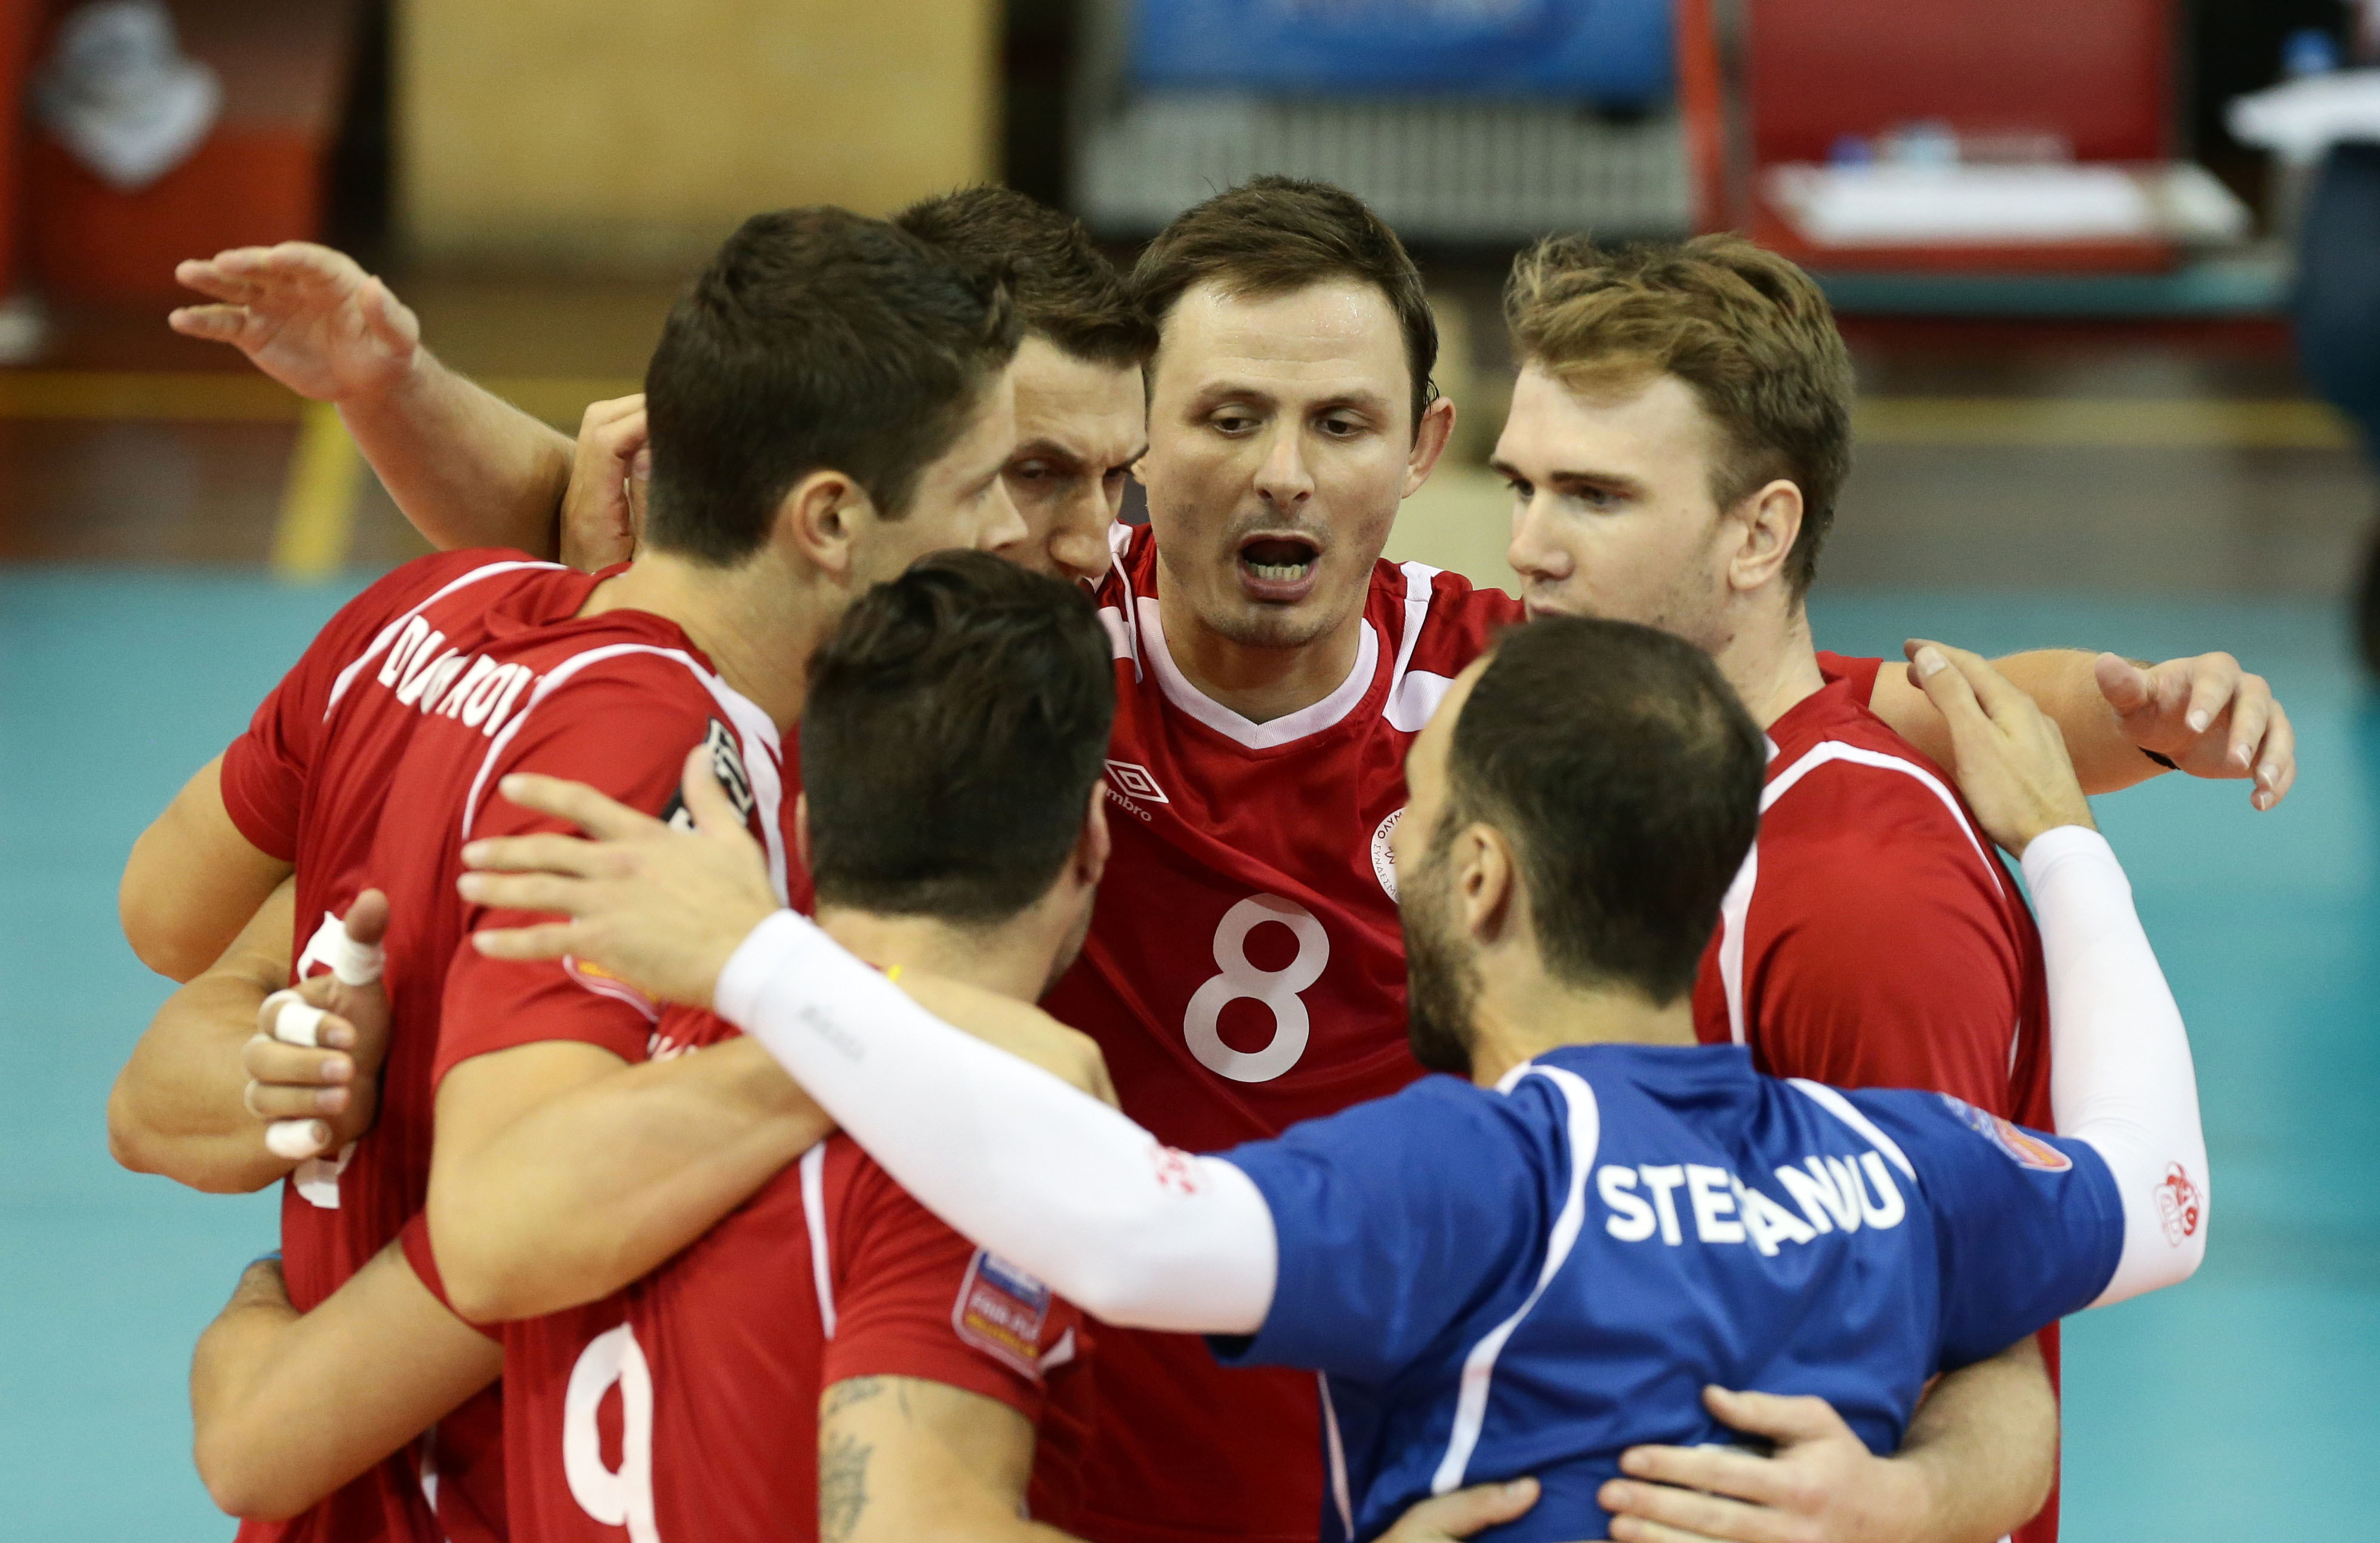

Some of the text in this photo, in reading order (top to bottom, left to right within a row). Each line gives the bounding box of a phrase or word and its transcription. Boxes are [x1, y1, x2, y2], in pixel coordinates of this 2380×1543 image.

[1106, 788, 1152, 822] mbro
[1377, 811, 1403, 840] ΟΛΥΜ
[1183, 892, 1330, 1083] 8
[562, 1320, 661, 1543] 9
